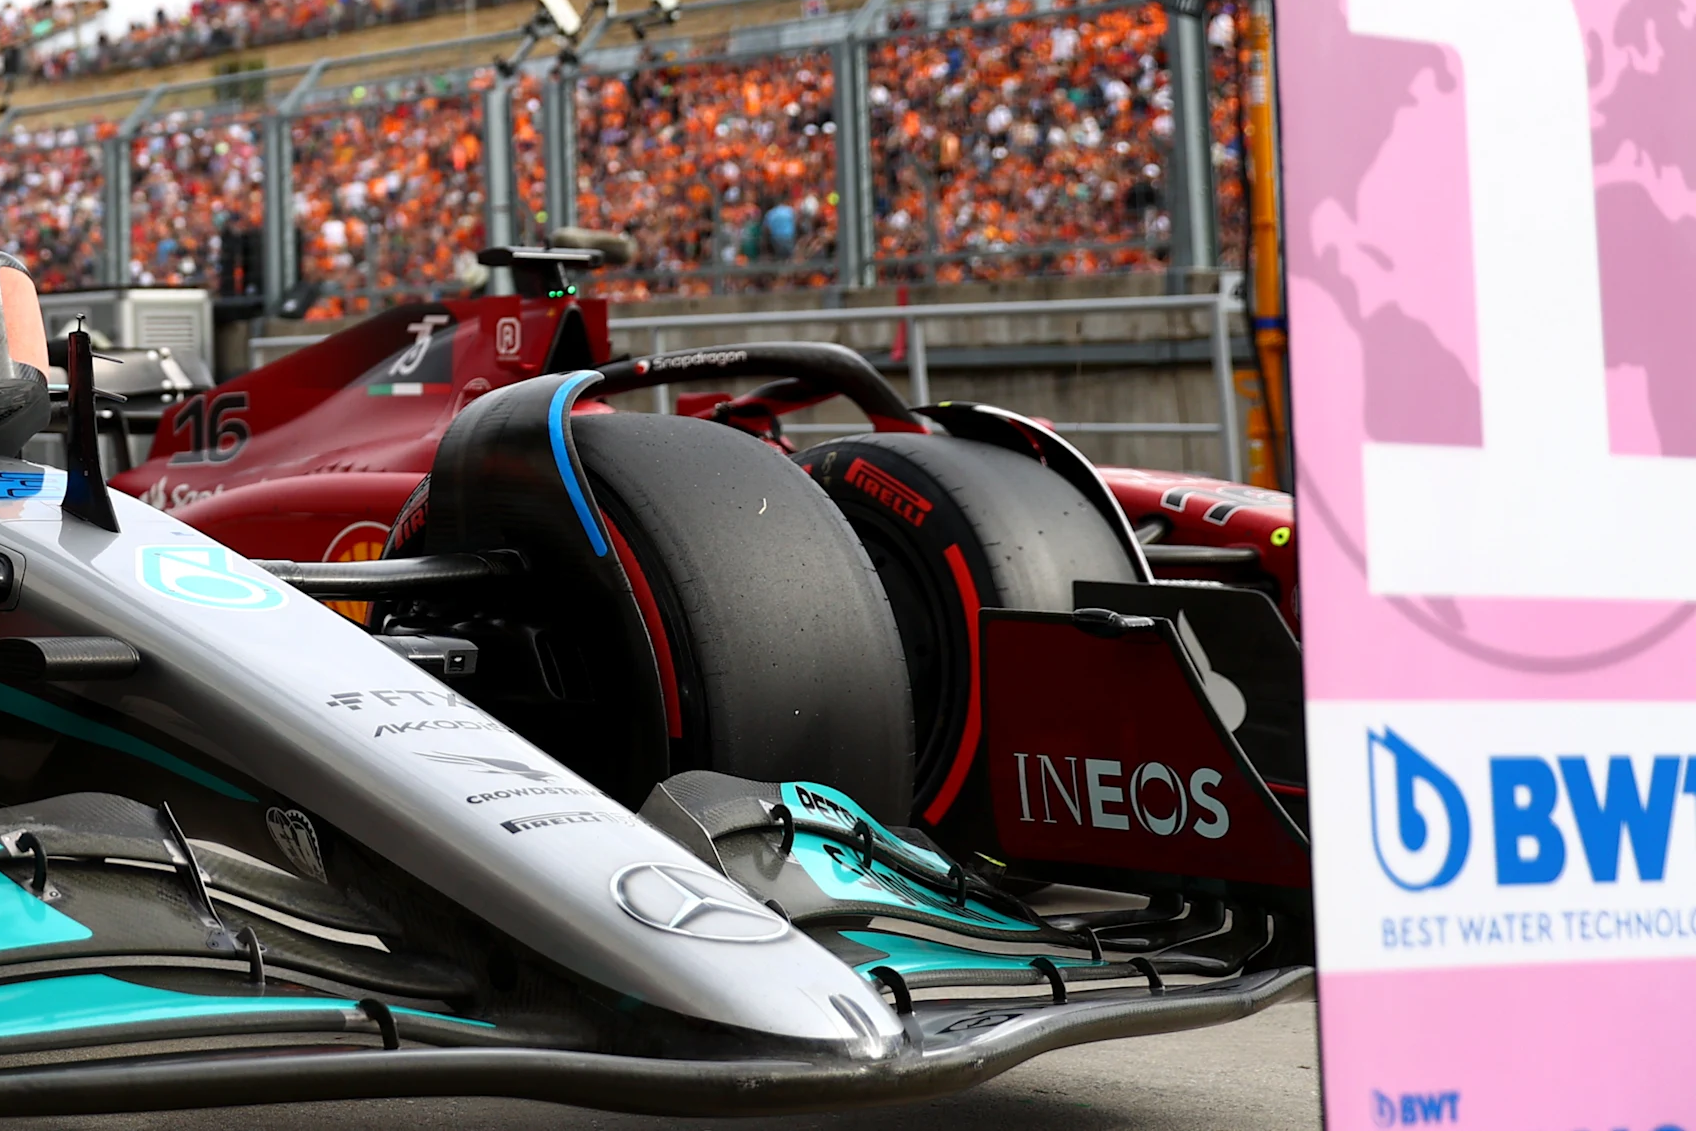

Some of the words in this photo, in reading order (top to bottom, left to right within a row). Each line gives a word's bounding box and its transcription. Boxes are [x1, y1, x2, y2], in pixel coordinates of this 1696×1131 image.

[653, 350, 747, 371] Snapdragon
[167, 391, 250, 467] 16
[844, 457, 933, 527] PIRELLI
[500, 811, 602, 834] PIRELLI
[1014, 752, 1230, 839] INEOS
[1489, 754, 1696, 886] BW
[1381, 915, 1448, 950] BEST
[1458, 911, 1554, 945] WATER
[1400, 1092, 1460, 1125] BWT
